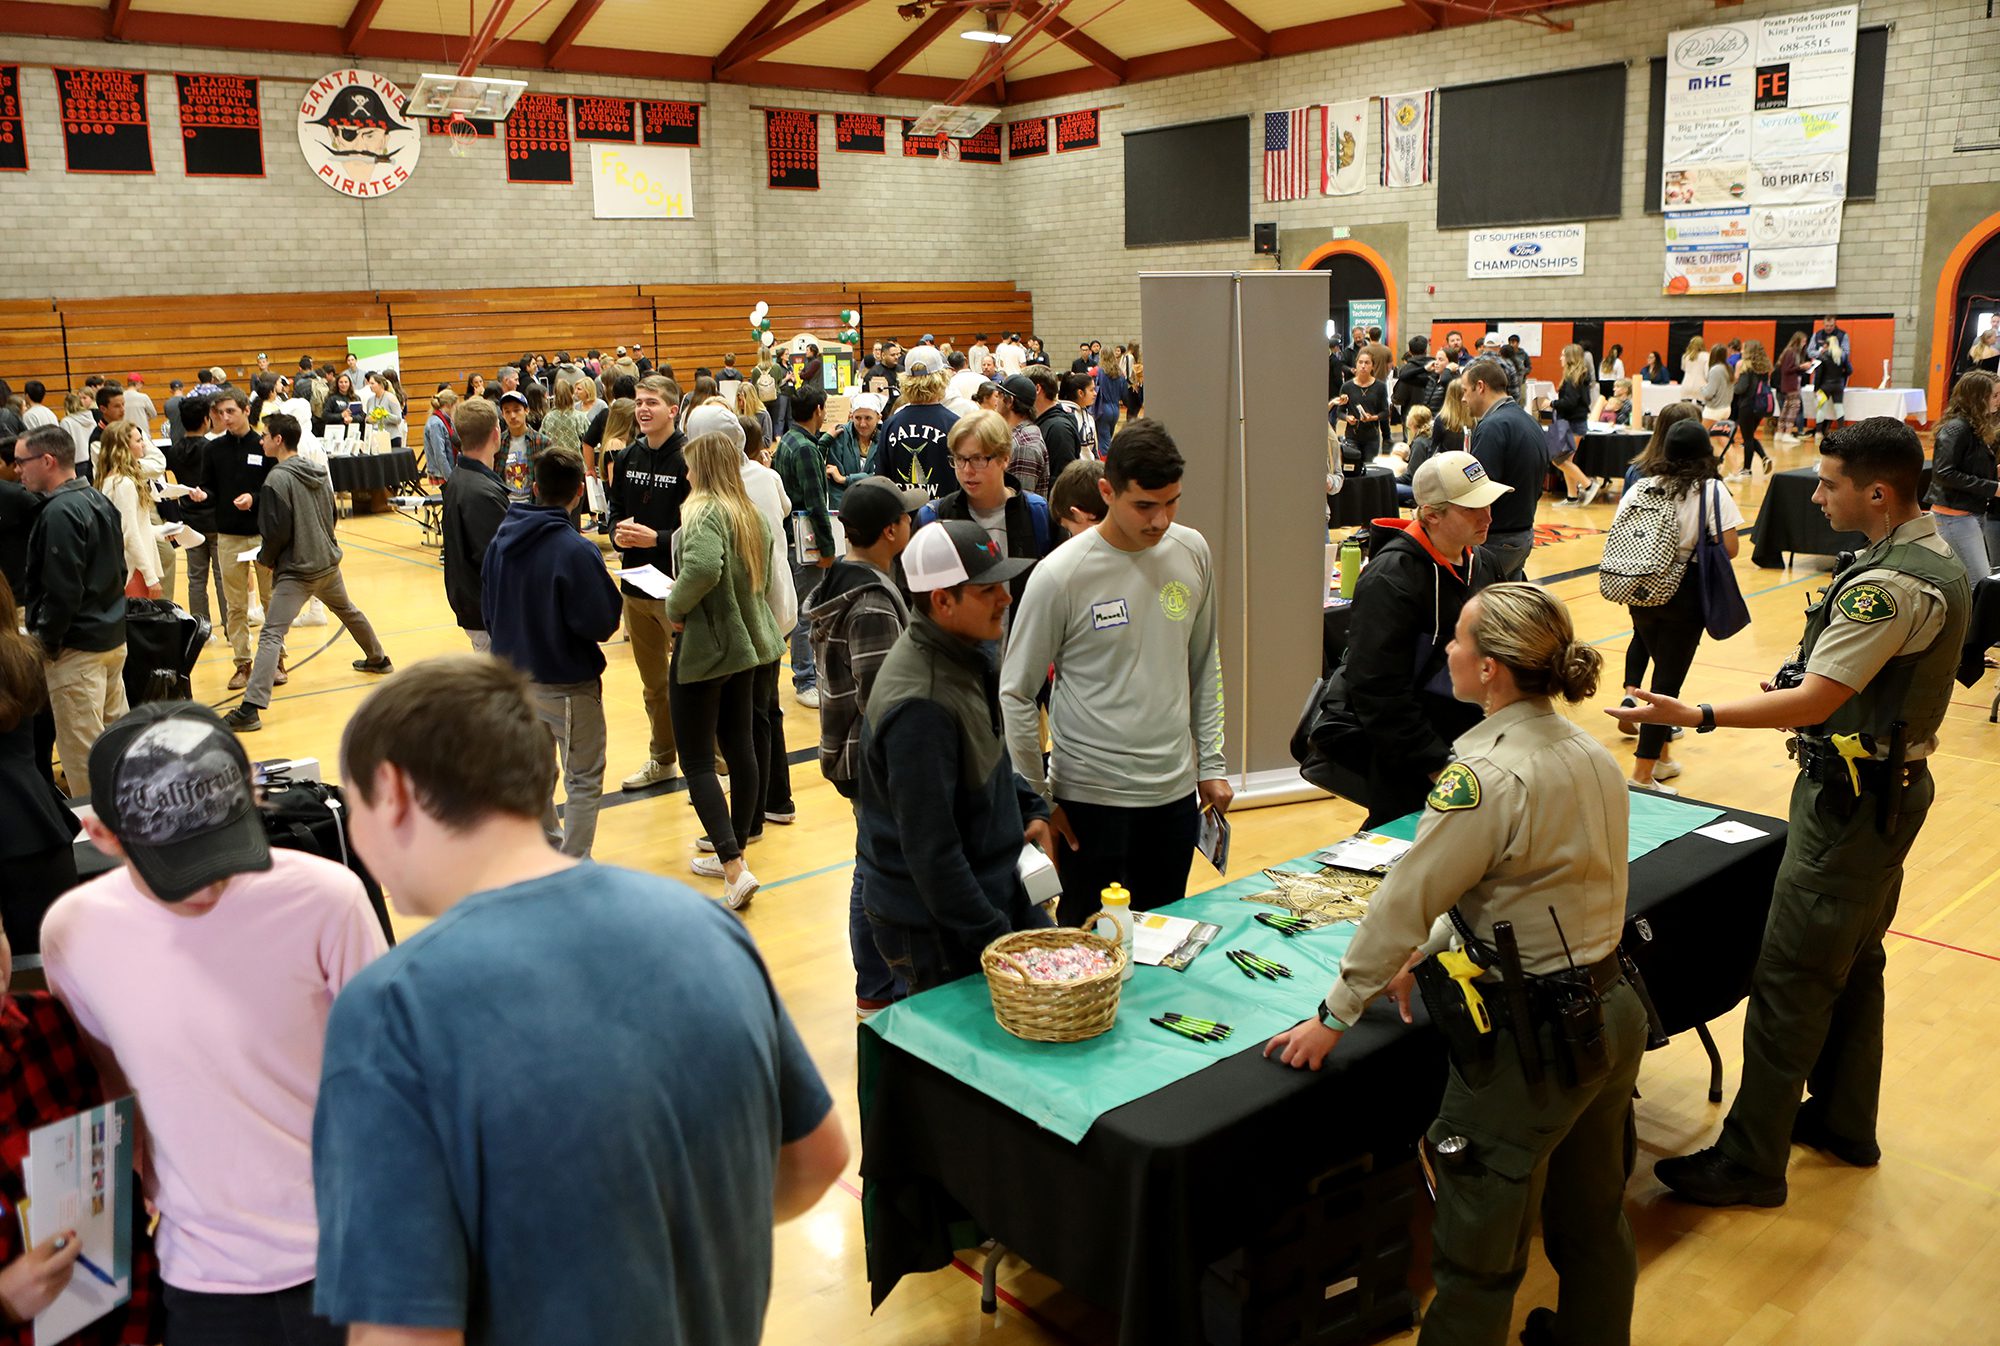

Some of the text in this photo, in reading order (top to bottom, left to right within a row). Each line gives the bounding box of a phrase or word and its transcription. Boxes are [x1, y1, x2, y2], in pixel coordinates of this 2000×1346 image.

[1788, 16, 1808, 24] Pride
[1810, 9, 1852, 21] Supporter
[70, 72, 132, 84] LEAGUE
[189, 77, 245, 89] LEAGUE
[65, 81, 139, 93] CHAMPIONS
[1757, 72, 1787, 99] FE
[71, 90, 135, 101] GIRLS TENNIS
[184, 87, 252, 98] CHAMPIONS
[301, 71, 359, 117] SANTA
[372, 74, 416, 122] YNE
[188, 96, 250, 107] FOOTBALL
[517, 96, 558, 107] EAGUE
[583, 100, 626, 110] LEAGUE
[512, 104, 563, 115] HAMPIONS
[578, 106, 631, 117] CHAMPIONS
[650, 104, 690, 113] LEAGUE
[527, 112, 567, 121] BASKETBALL
[581, 113, 628, 124] BASEBALL
[645, 110, 695, 121] CHAMPIONS
[774, 112, 810, 121] LEAGUE
[843, 114, 878, 123] LEAGUE
[1062, 112, 1093, 124] LEAGUE
[648, 118, 693, 127] SOFTBALL
[770, 119, 815, 129] CHAMPIONS
[840, 121, 882, 130] CHAMPIONS
[1014, 120, 1042, 131] LEAGUE
[1060, 118, 1095, 130] CHAMPIONS
[1079, 123, 1095, 132] GOLF
[1012, 127, 1045, 137] CHAMPIONS
[318, 165, 408, 196] PIRATES
[601, 151, 684, 217] FROSH
[1762, 176, 1777, 187] GO
[1780, 170, 1834, 186] PIRATES!
[1489, 231, 1538, 242] SOUTHERN
[1539, 229, 1580, 239] SECTION
[1514, 244, 1538, 256] Ford
[1474, 257, 1578, 271] CHAMPIONSHIPS
[1675, 252, 1742, 265] MIKE QUIROGA
[1353, 303, 1382, 311] Veterinary
[1352, 310, 1382, 318] Technology
[1355, 318, 1379, 326] program
[889, 424, 946, 447] SALTY
[654, 473, 677, 484] YNEZ
[133, 763, 241, 812] California
